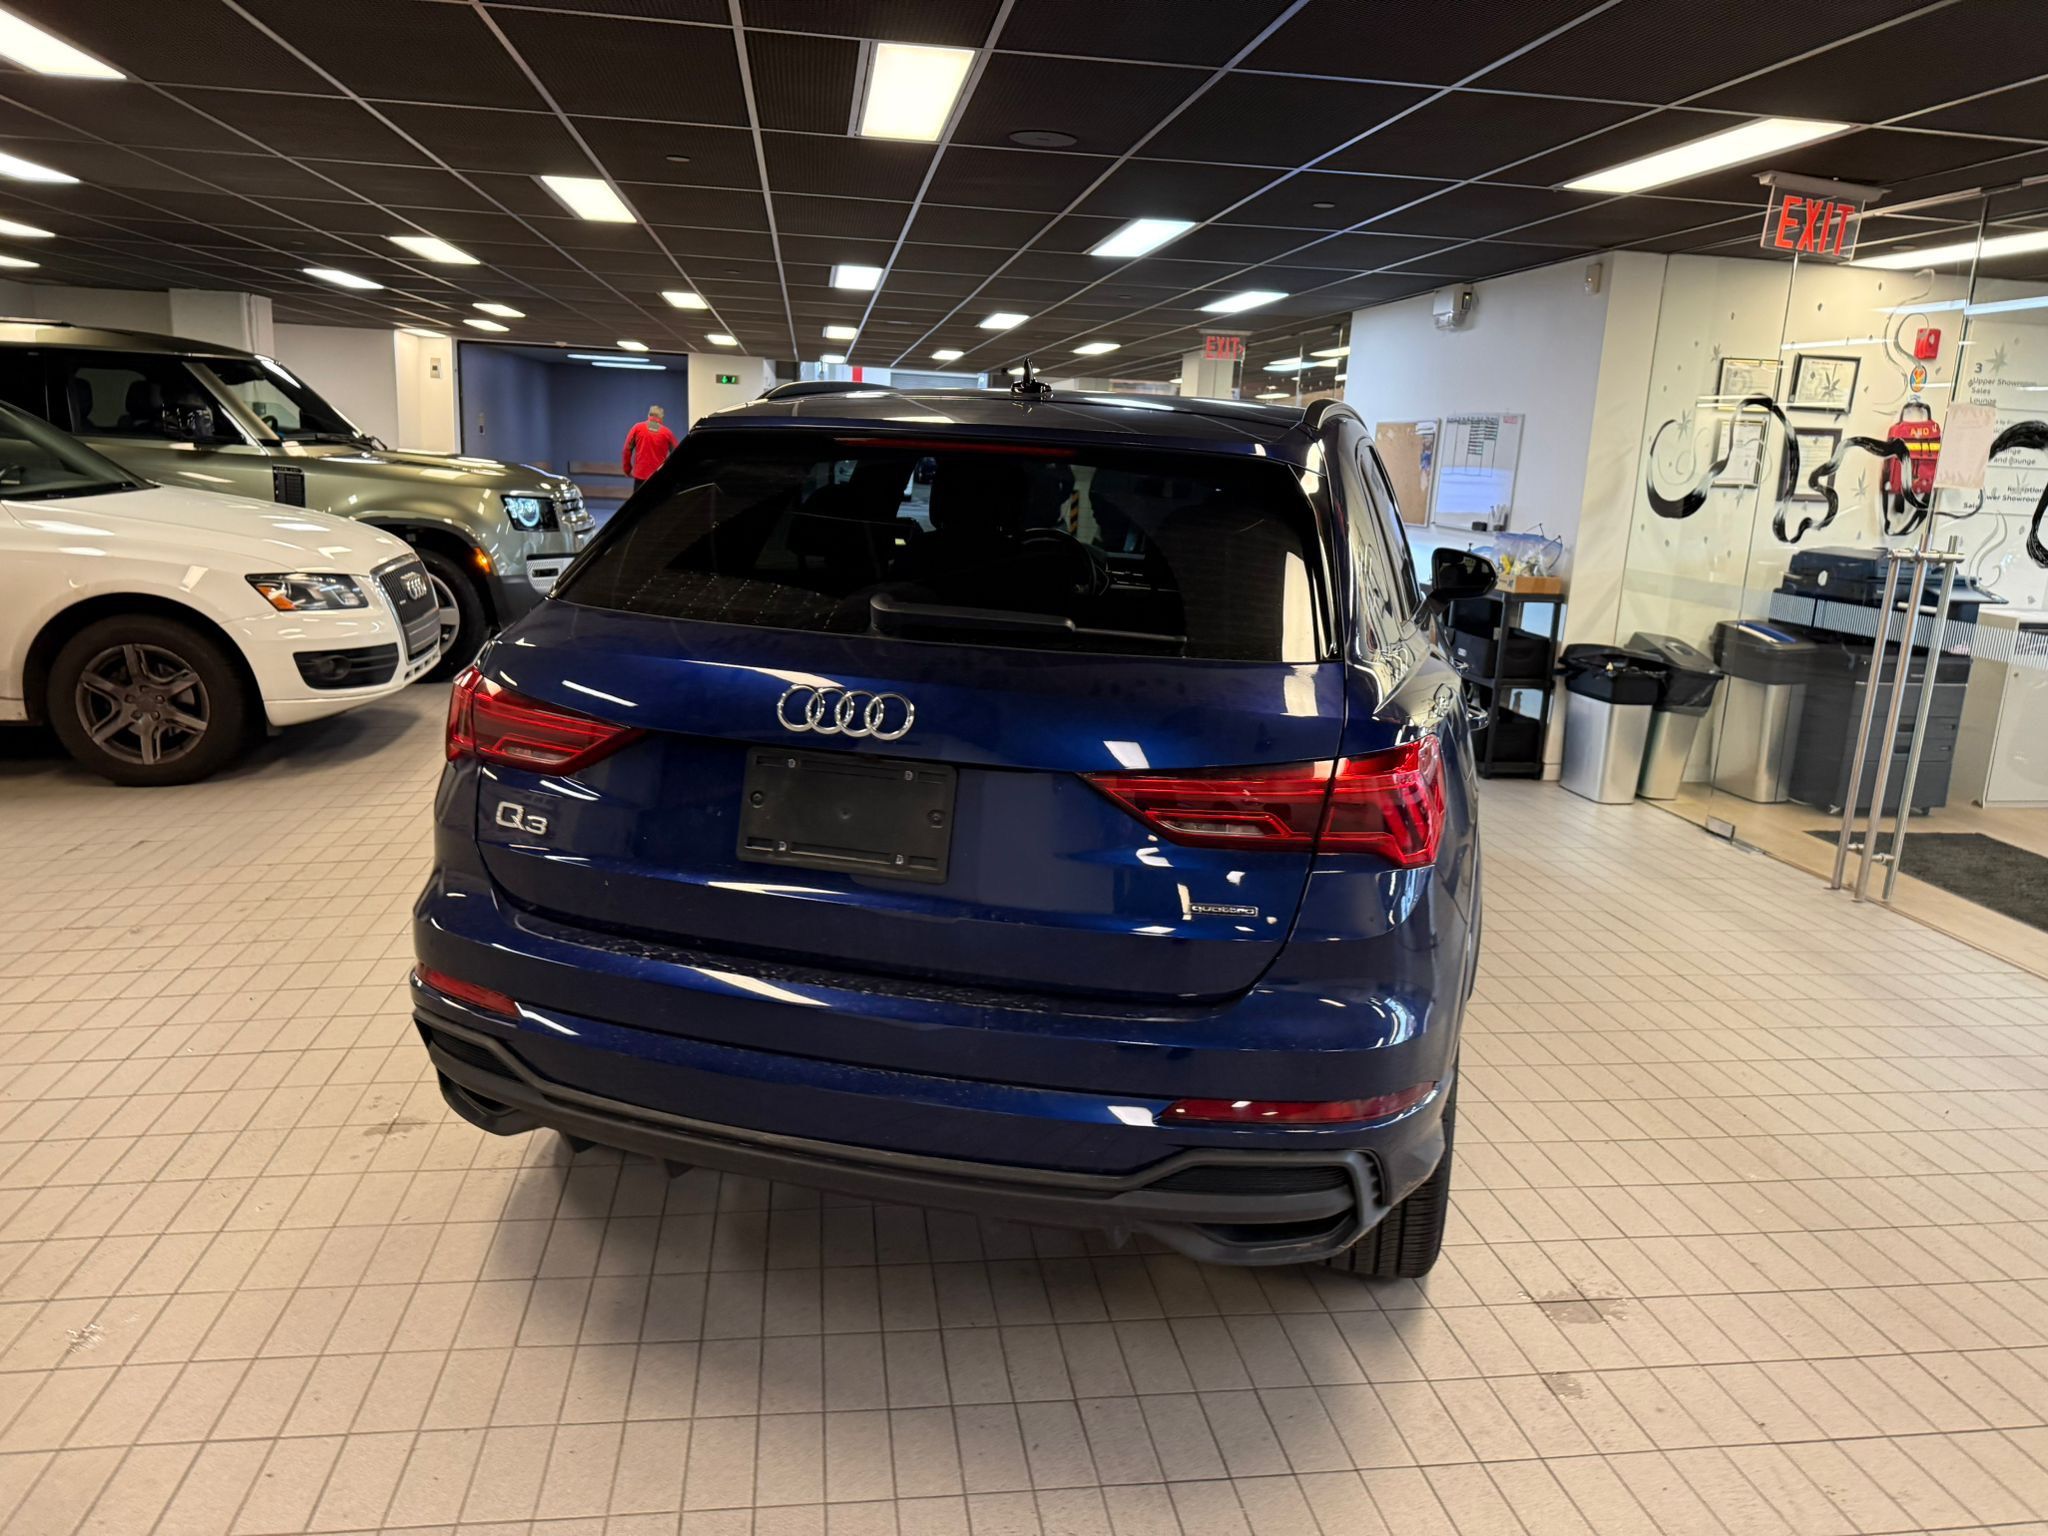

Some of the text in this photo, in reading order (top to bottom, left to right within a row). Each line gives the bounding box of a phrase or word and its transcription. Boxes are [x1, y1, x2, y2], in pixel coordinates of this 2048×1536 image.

[1775, 195, 1855, 257] EXIT
[1205, 336, 1240, 360] EXIT
[1974, 362, 1983, 374] 3
[1973, 377, 1996, 386] Upper
[1971, 387, 1991, 395] Sales
[2008, 457, 2036, 466] ounge
[496, 801, 548, 835] Q3
[1192, 905, 1254, 914] quattro
